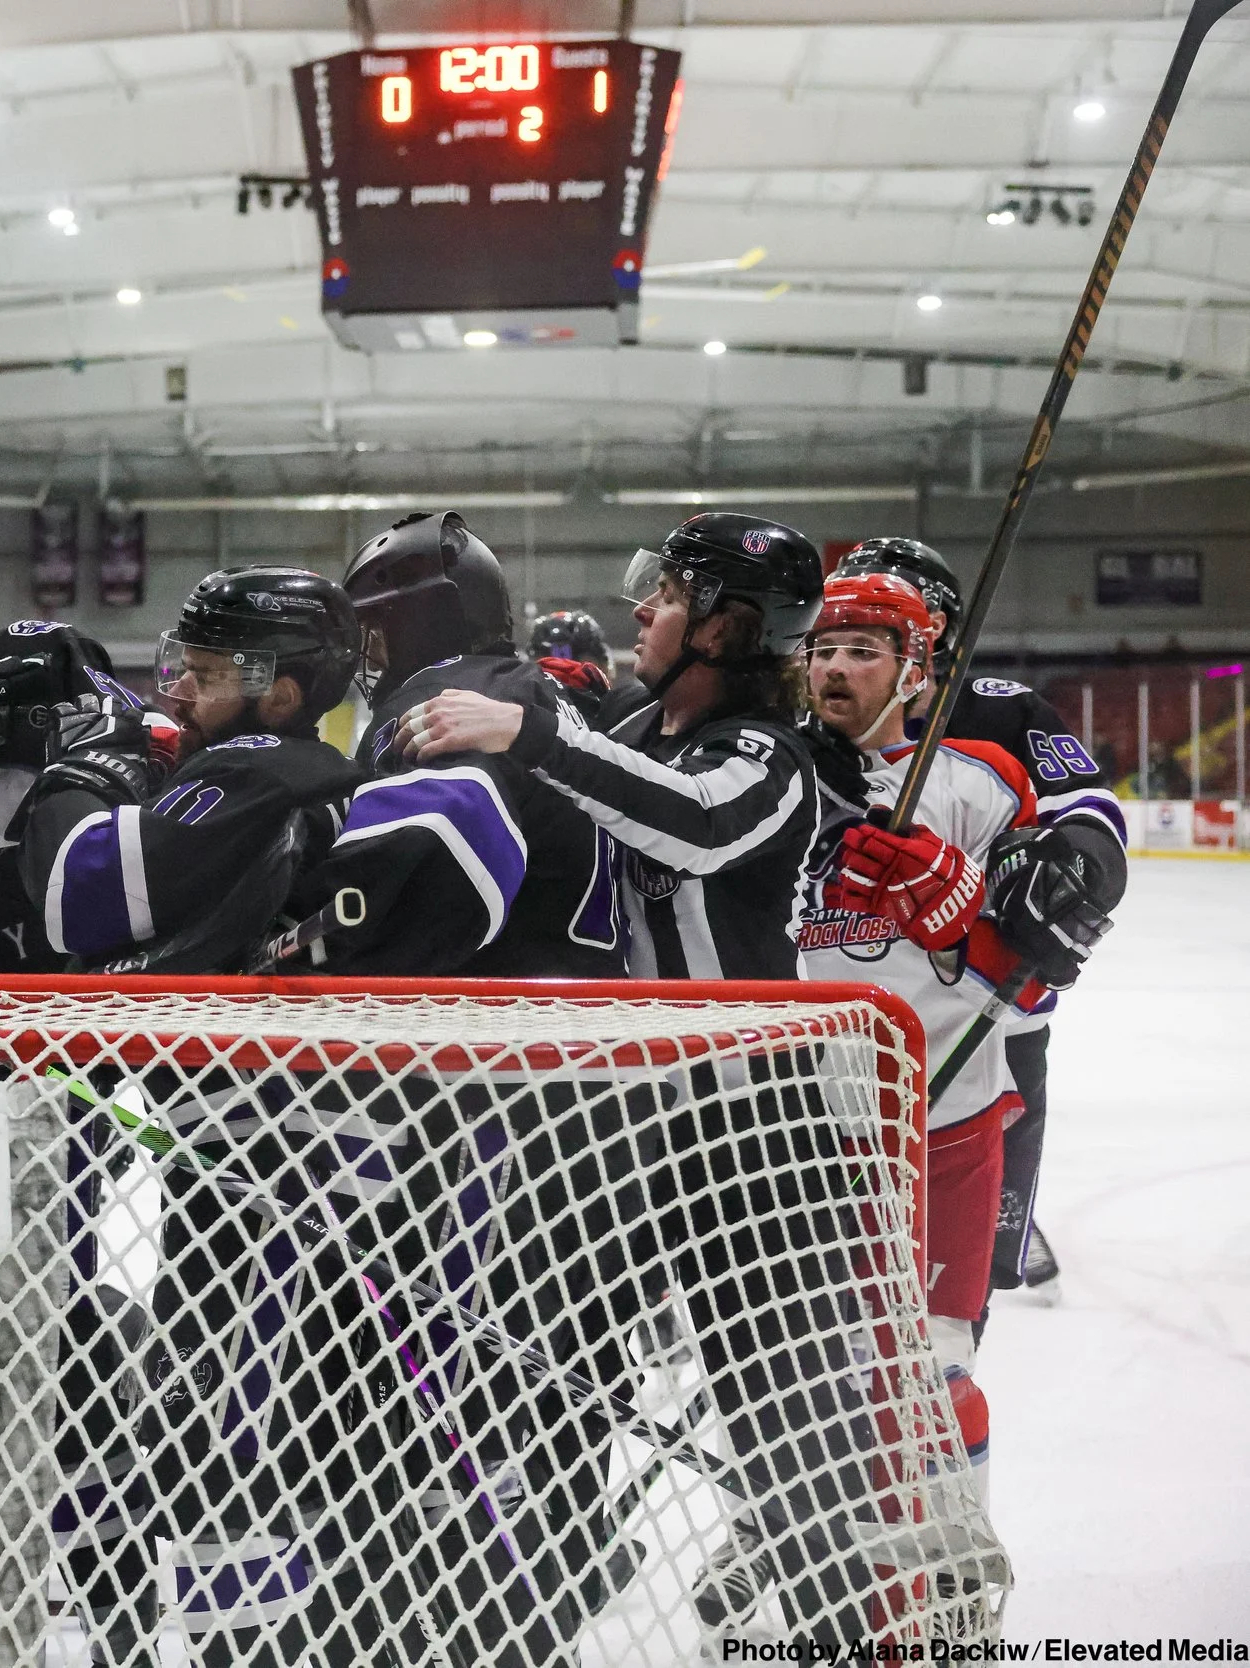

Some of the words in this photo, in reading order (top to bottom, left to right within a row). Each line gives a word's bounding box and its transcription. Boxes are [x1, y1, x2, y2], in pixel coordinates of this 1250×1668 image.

[439, 45, 539, 94] 12:00
[593, 70, 608, 113] 1
[381, 76, 412, 123] 0
[518, 105, 544, 142] 2
[1027, 730, 1100, 781] 59
[800, 920, 846, 949] ROCK
